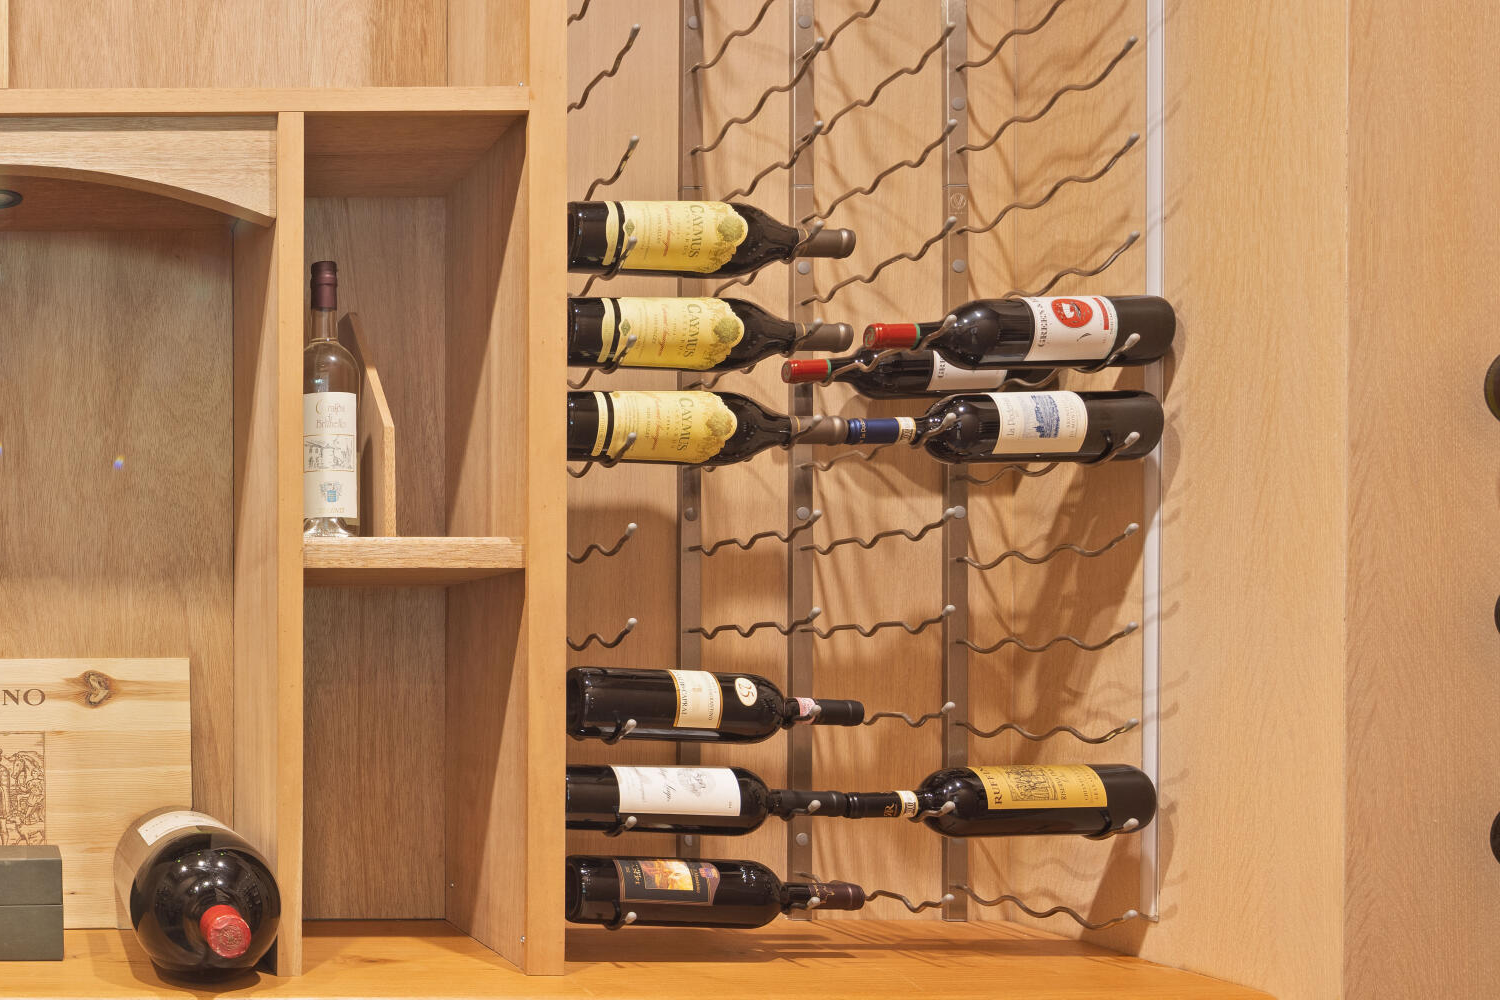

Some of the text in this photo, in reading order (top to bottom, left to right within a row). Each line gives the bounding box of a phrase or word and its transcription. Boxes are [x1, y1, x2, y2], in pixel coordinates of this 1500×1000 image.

[688, 204, 705, 258] CAYMUS
[683, 303, 702, 358] CAYMUS
[676, 397, 694, 451] CAYMUS
